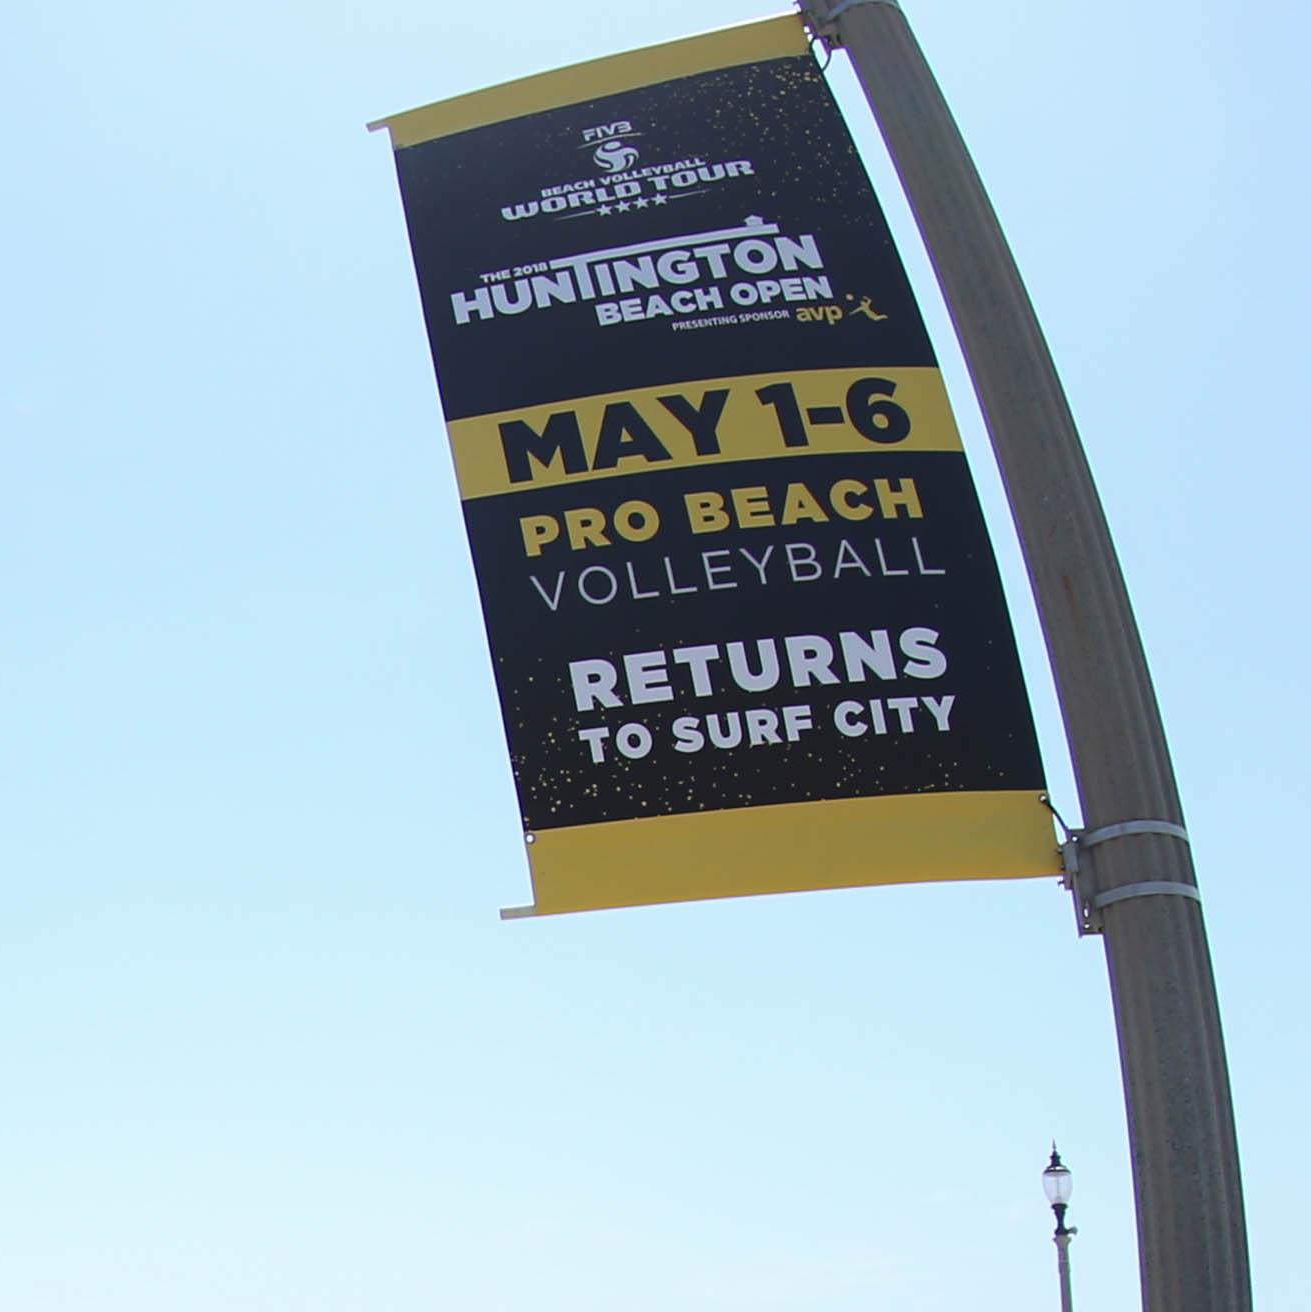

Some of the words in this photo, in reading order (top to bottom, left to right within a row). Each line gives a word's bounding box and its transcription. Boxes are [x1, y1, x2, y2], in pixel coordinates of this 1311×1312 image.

[501, 181, 640, 221] WORLD
[648, 159, 755, 192] TOUR
[540, 178, 595, 197] BEACH
[599, 157, 706, 185] VOLLEYBALL
[450, 234, 824, 325] HUNTINGTON
[480, 269, 511, 284] THE
[513, 262, 548, 278] 2018
[595, 285, 724, 327] BEACH
[730, 276, 833, 310] OPEN
[672, 315, 737, 331] PRESENTING
[739, 309, 789, 325] SPONSOR
[795, 304, 843, 325] avp
[498, 388, 731, 485] MAY
[756, 376, 912, 448] 1-6
[519, 500, 660, 557] PRO
[684, 478, 924, 534] BEACH
[529, 536, 946, 611] VOLLEYBALL
[568, 627, 948, 712] RETURNS
[578, 722, 653, 763] TO
[673, 704, 813, 754] SURF
[833, 695, 956, 738] CITY
